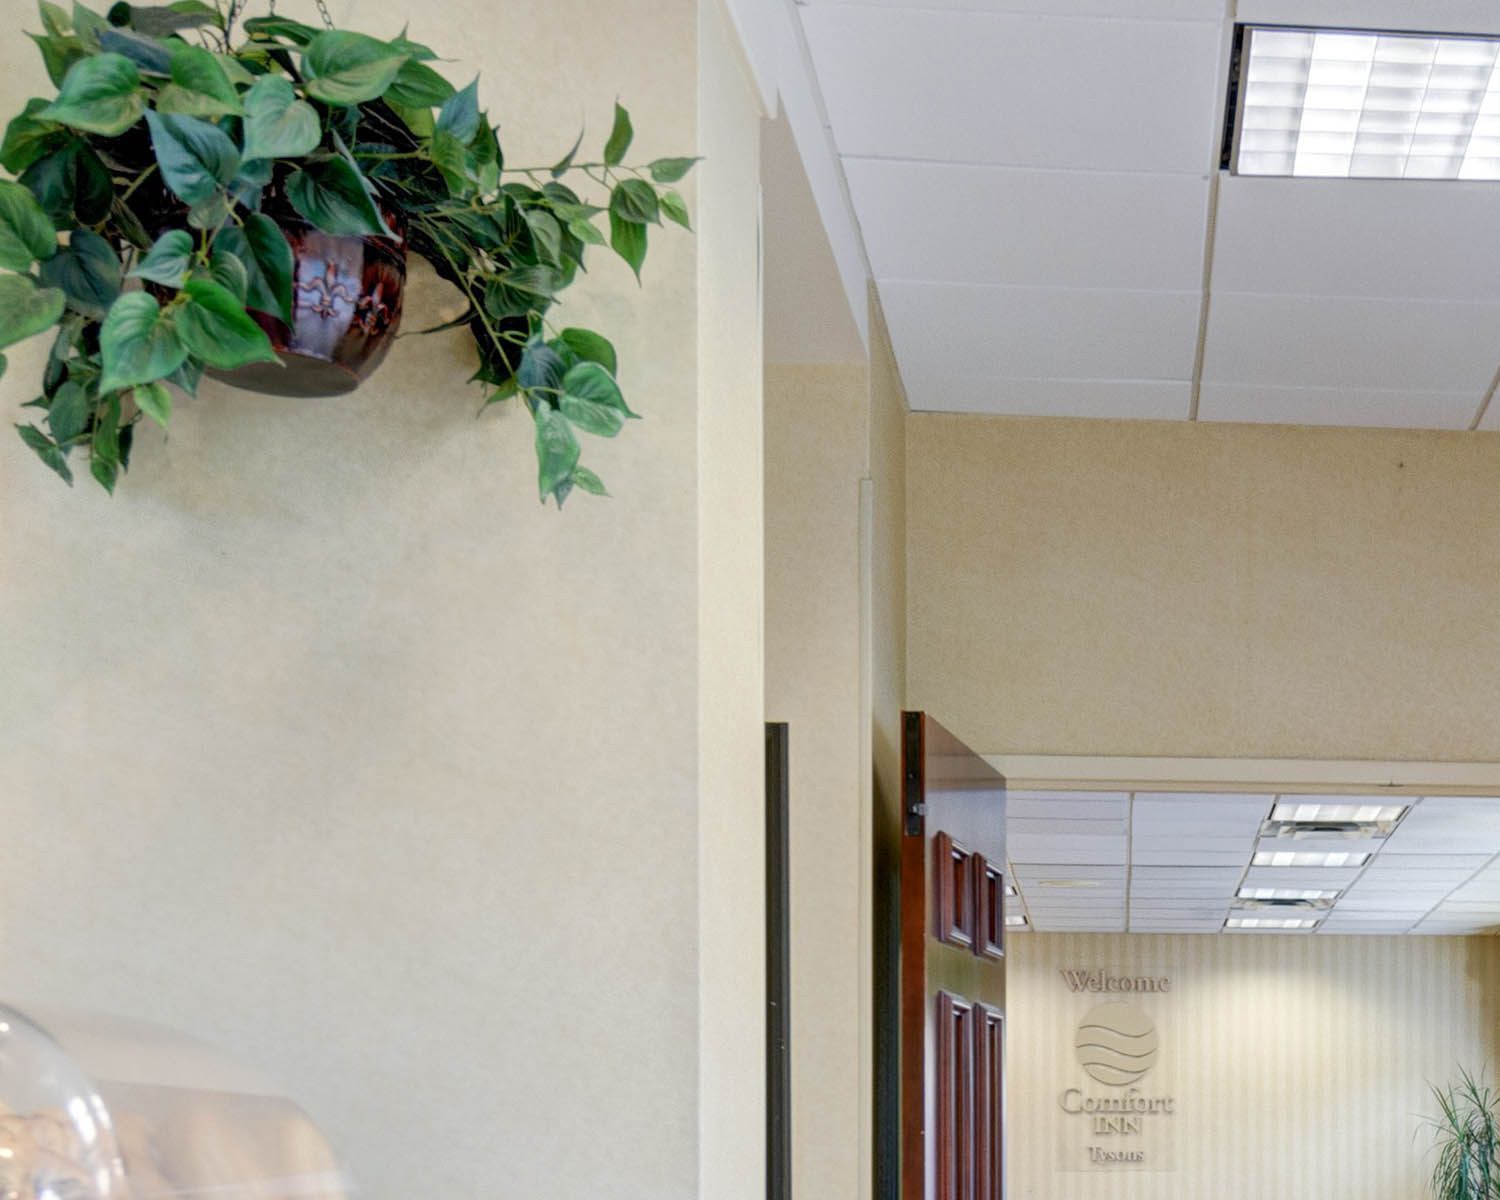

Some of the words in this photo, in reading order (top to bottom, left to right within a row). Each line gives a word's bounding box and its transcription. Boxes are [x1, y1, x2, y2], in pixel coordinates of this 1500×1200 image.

[1059, 968, 1171, 993] Welcome
[1060, 1088, 1175, 1115] Comfort
[1093, 1116, 1143, 1136] INN
[1088, 1147, 1145, 1164] Tysons
